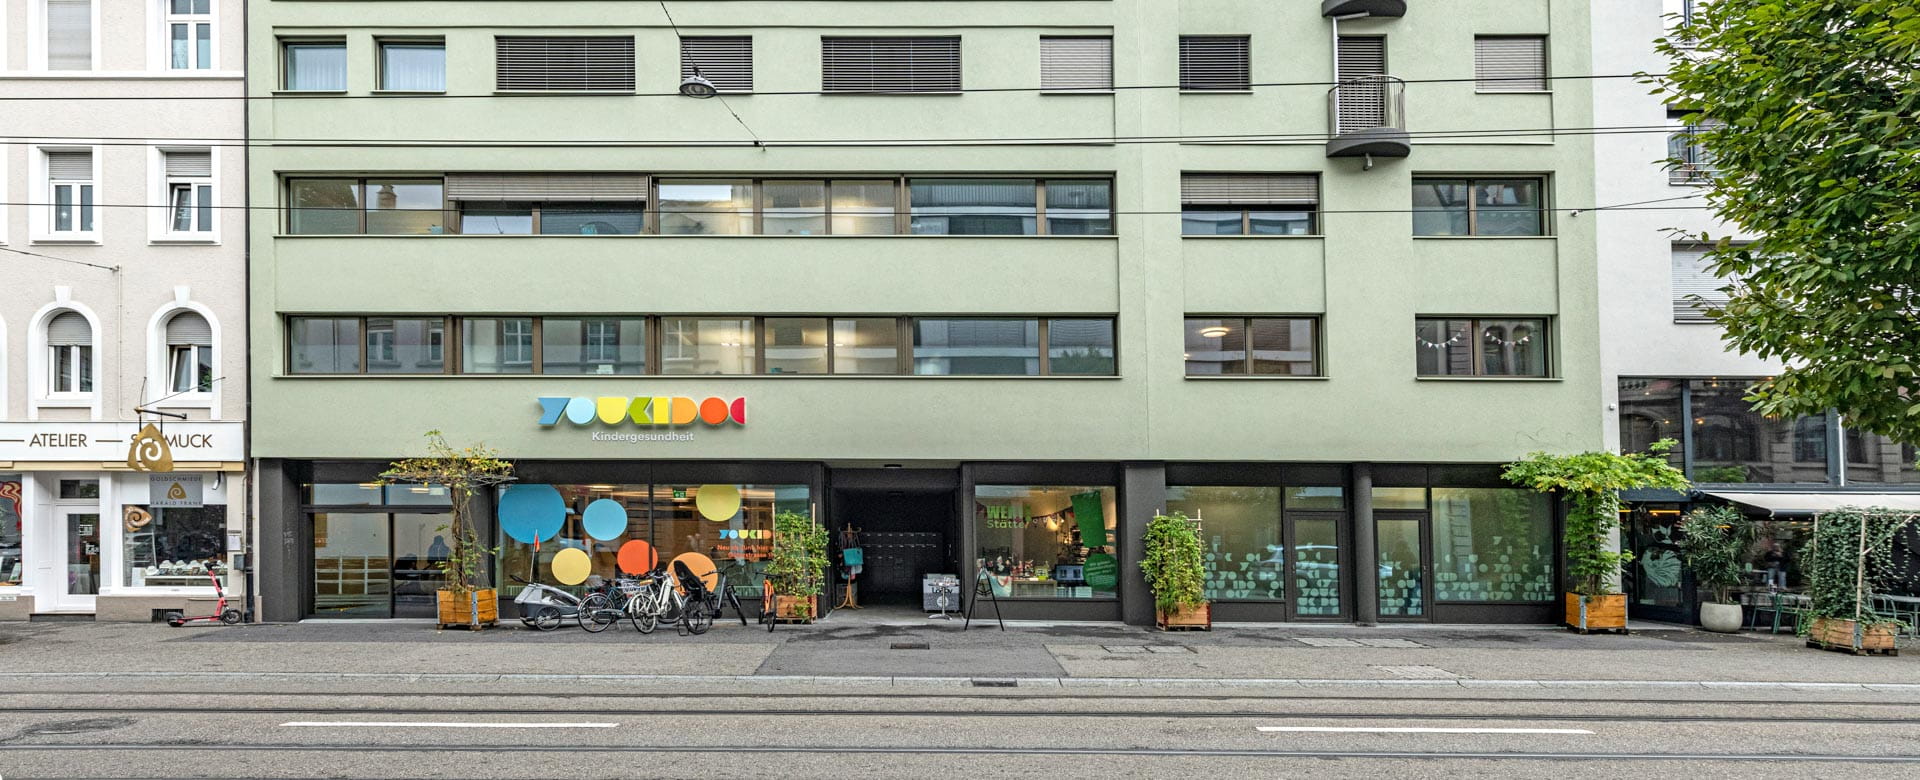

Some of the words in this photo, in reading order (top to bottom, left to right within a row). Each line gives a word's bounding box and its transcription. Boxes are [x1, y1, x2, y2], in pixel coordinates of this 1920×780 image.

[29, 433, 88, 448] ATELIER
[130, 433, 213, 448] SMUCK
[592, 431, 695, 443] Kindergesundheit
[986, 519, 1025, 529] Stätte
[719, 529, 772, 540] YOUKID
